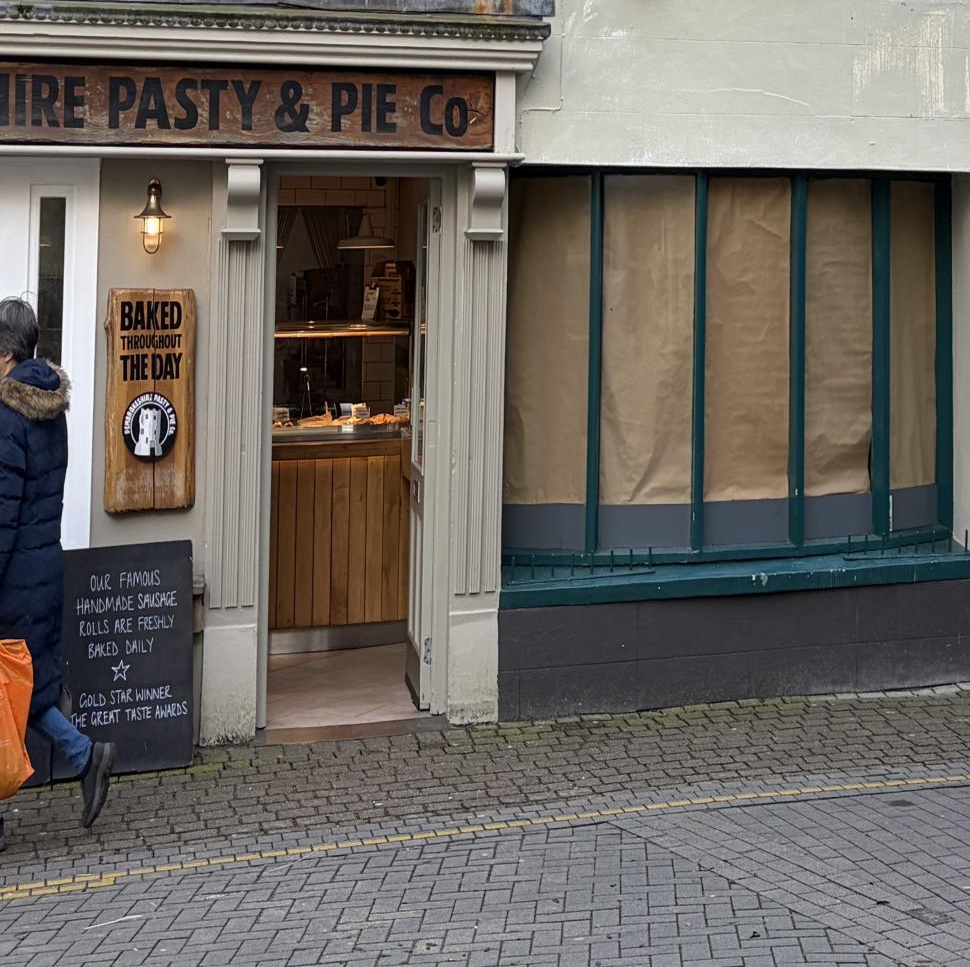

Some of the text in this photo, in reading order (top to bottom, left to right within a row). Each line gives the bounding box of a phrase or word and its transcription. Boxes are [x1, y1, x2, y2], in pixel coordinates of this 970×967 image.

[108, 76, 262, 131] PASTY
[275, 80, 310, 133] &
[331, 82, 397, 134] PIE
[120, 301, 182, 331] BAKED
[120, 334, 182, 350] THROUGHOUT
[120, 352, 183, 381] THE DAY
[90, 570, 160, 592] OUR FAMOUS
[76, 590, 178, 616] HANDMADE SAUSAGE
[79, 614, 175, 637] ROLLS ARE FRESHLY
[88, 637, 154, 659] BAKED DAILY
[79, 685, 172, 709] GOLD STAR WINNER
[70, 700, 188, 728] THE GREAT TASTE AWARDS
